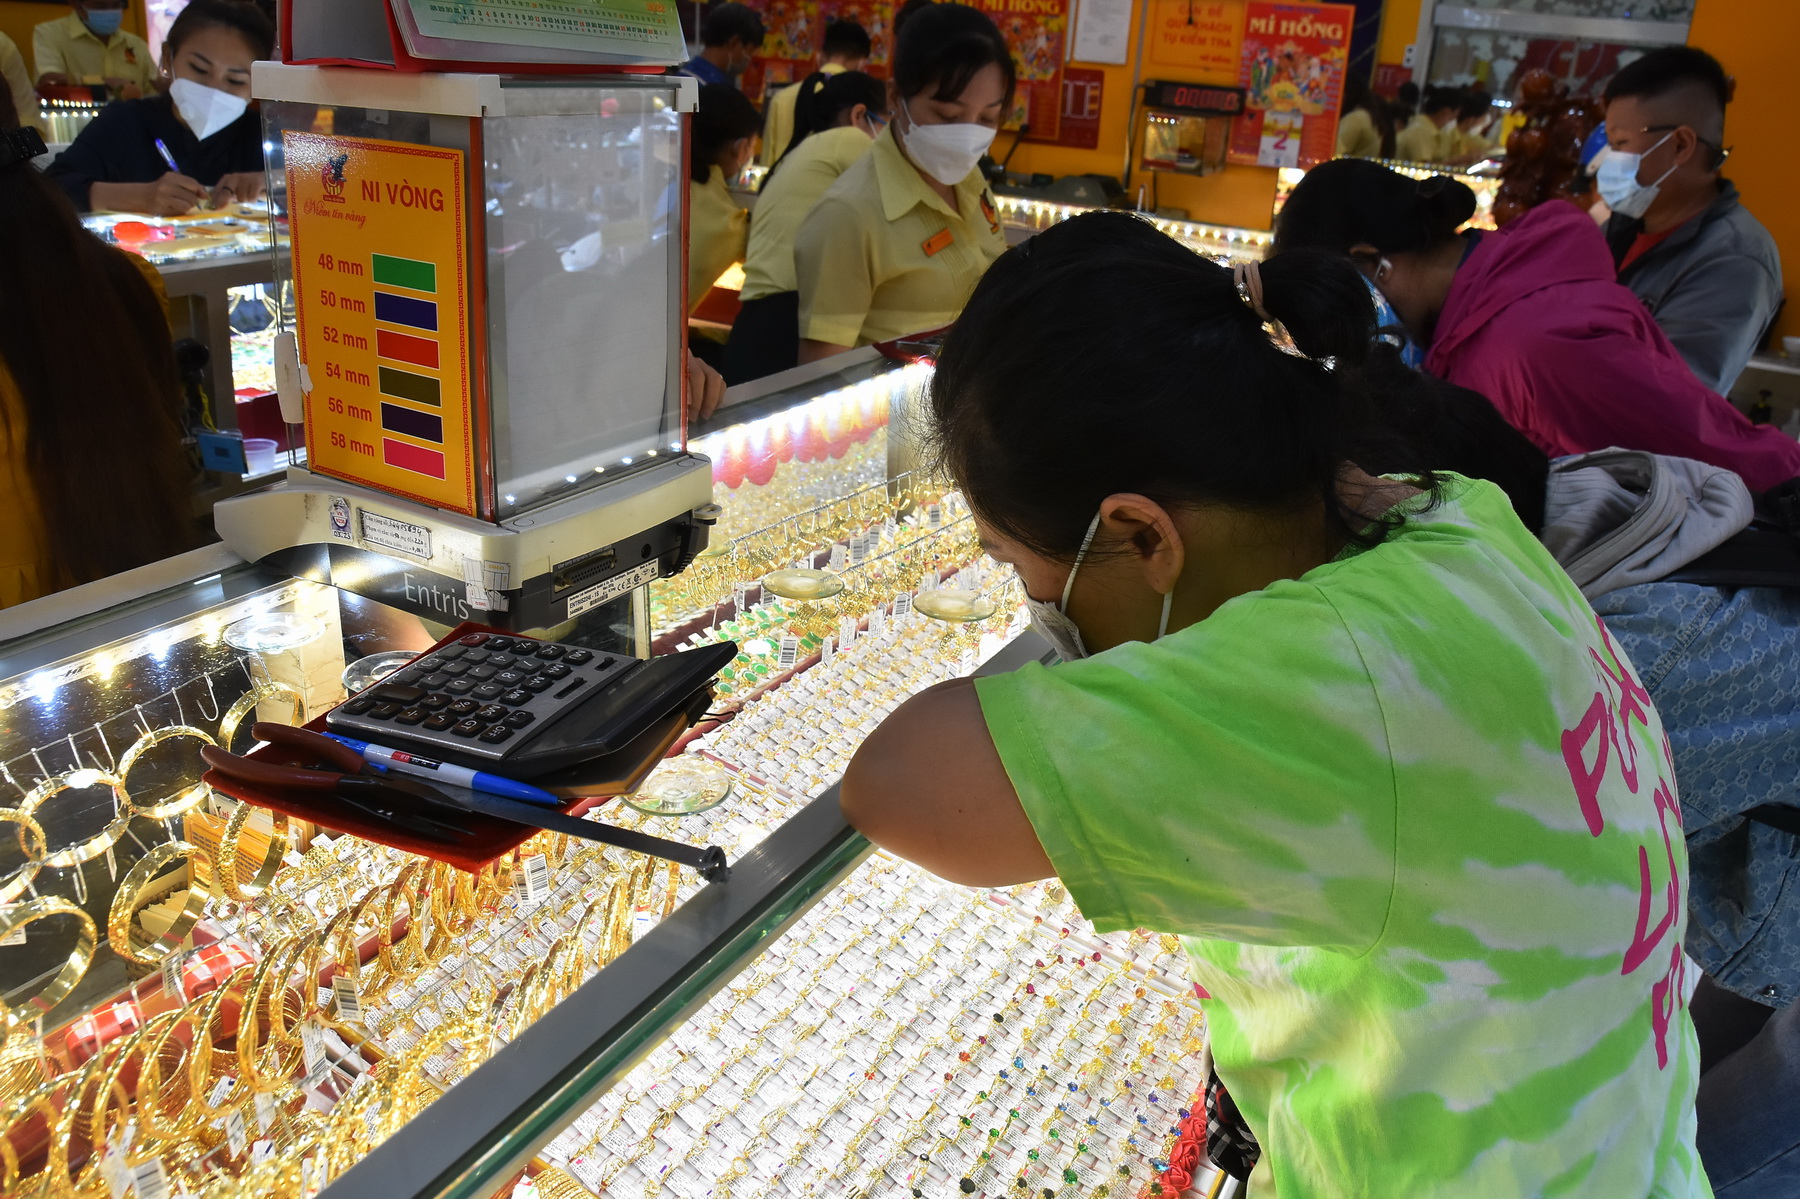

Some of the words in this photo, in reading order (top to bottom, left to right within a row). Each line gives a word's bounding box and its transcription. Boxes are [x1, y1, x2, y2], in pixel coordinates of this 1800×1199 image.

[1273, 130, 1289, 150] 2
[361, 179, 380, 203] NI
[386, 179, 444, 211] VÒNG
[332, 209, 343, 219] tin
[318, 253, 334, 270] 48
[338, 259, 364, 276] mm
[320, 289, 336, 307] 50
[341, 297, 365, 313] mm
[323, 326, 339, 343] 52
[343, 333, 368, 350] mm
[325, 362, 341, 379] 54
[345, 369, 370, 387] mm
[328, 397, 344, 414] 56
[348, 405, 373, 422] mm
[331, 431, 346, 449] 58
[350, 439, 375, 457] mm
[404, 572, 469, 620] Entris
[460, 720, 477, 730] GT
[489, 725, 506, 738] OFF
